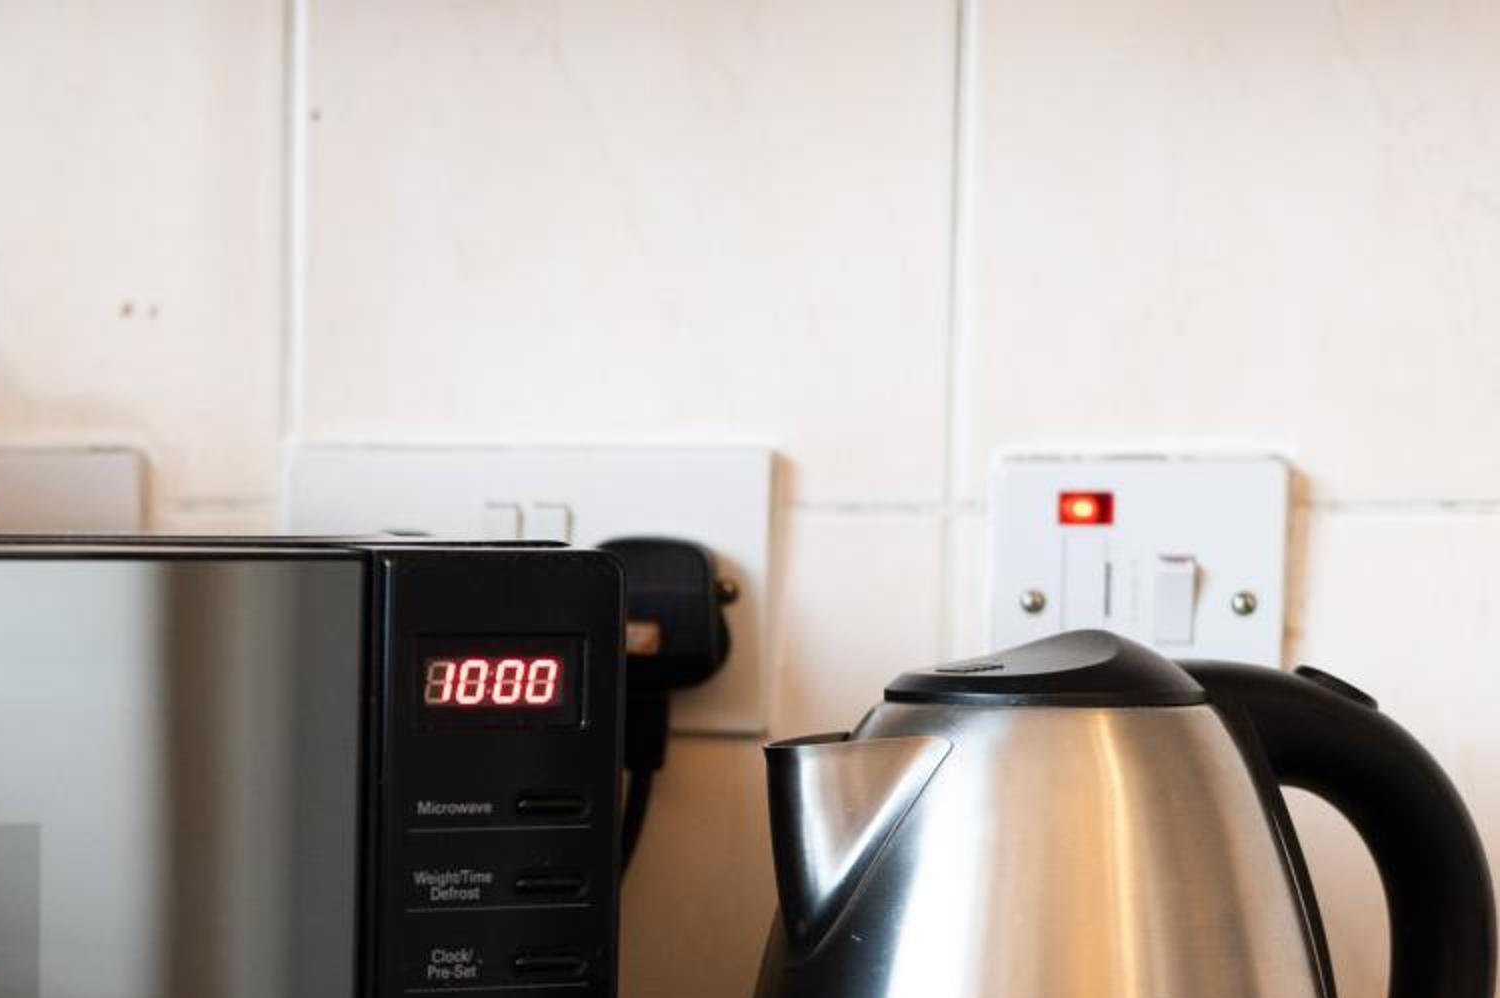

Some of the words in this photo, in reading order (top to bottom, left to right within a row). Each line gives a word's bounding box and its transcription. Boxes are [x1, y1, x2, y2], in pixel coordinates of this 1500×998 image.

[417, 801, 493, 815] Microwave
[430, 886, 480, 900] Defrost
[427, 963, 477, 979] Pre-Set
